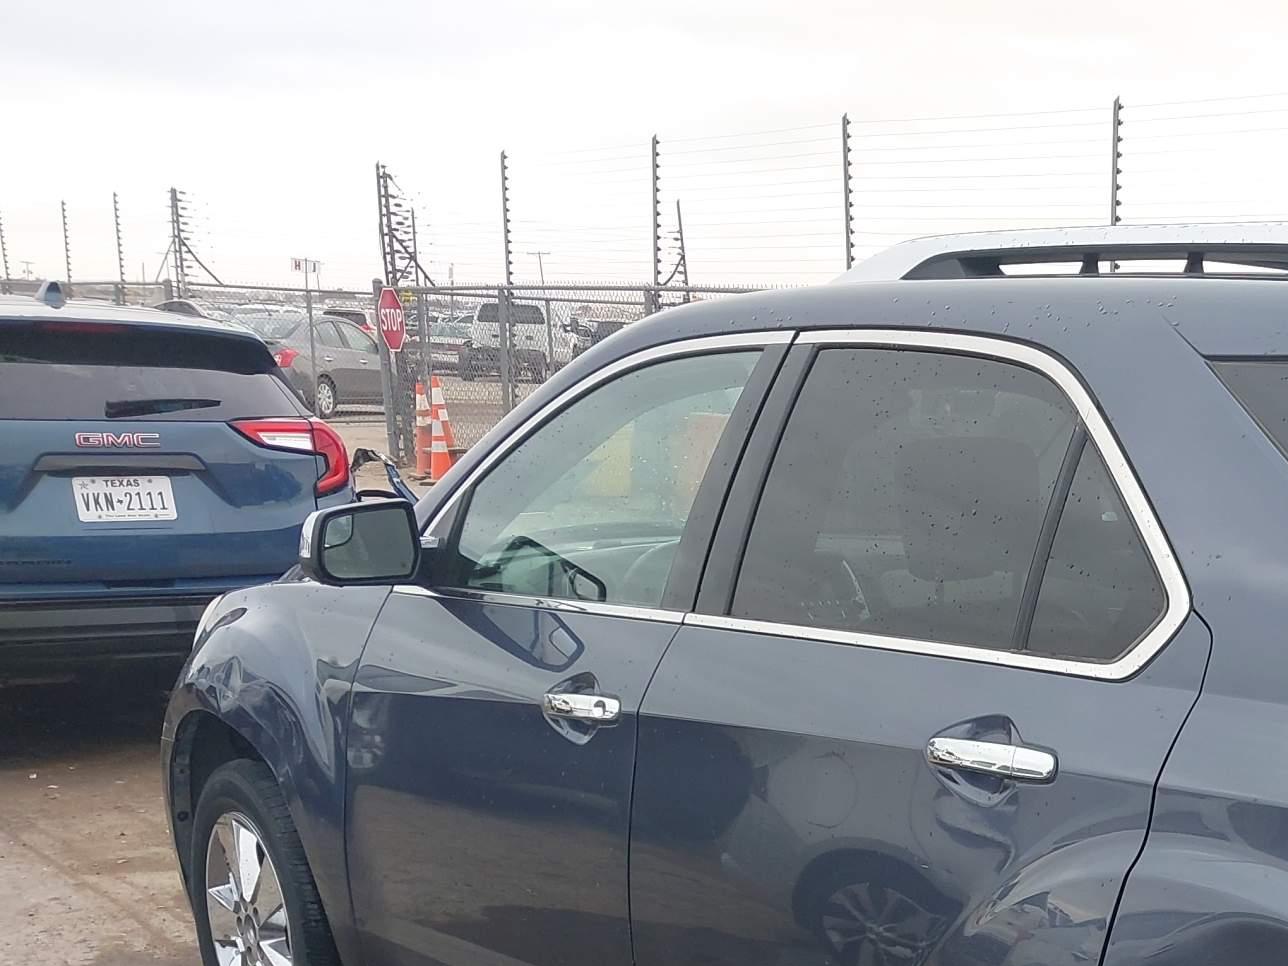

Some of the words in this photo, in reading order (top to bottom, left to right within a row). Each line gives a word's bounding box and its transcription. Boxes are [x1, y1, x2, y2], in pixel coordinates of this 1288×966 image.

[380, 308, 402, 332] STOP
[75, 432, 161, 448] GMC
[103, 478, 140, 488] TEXAS
